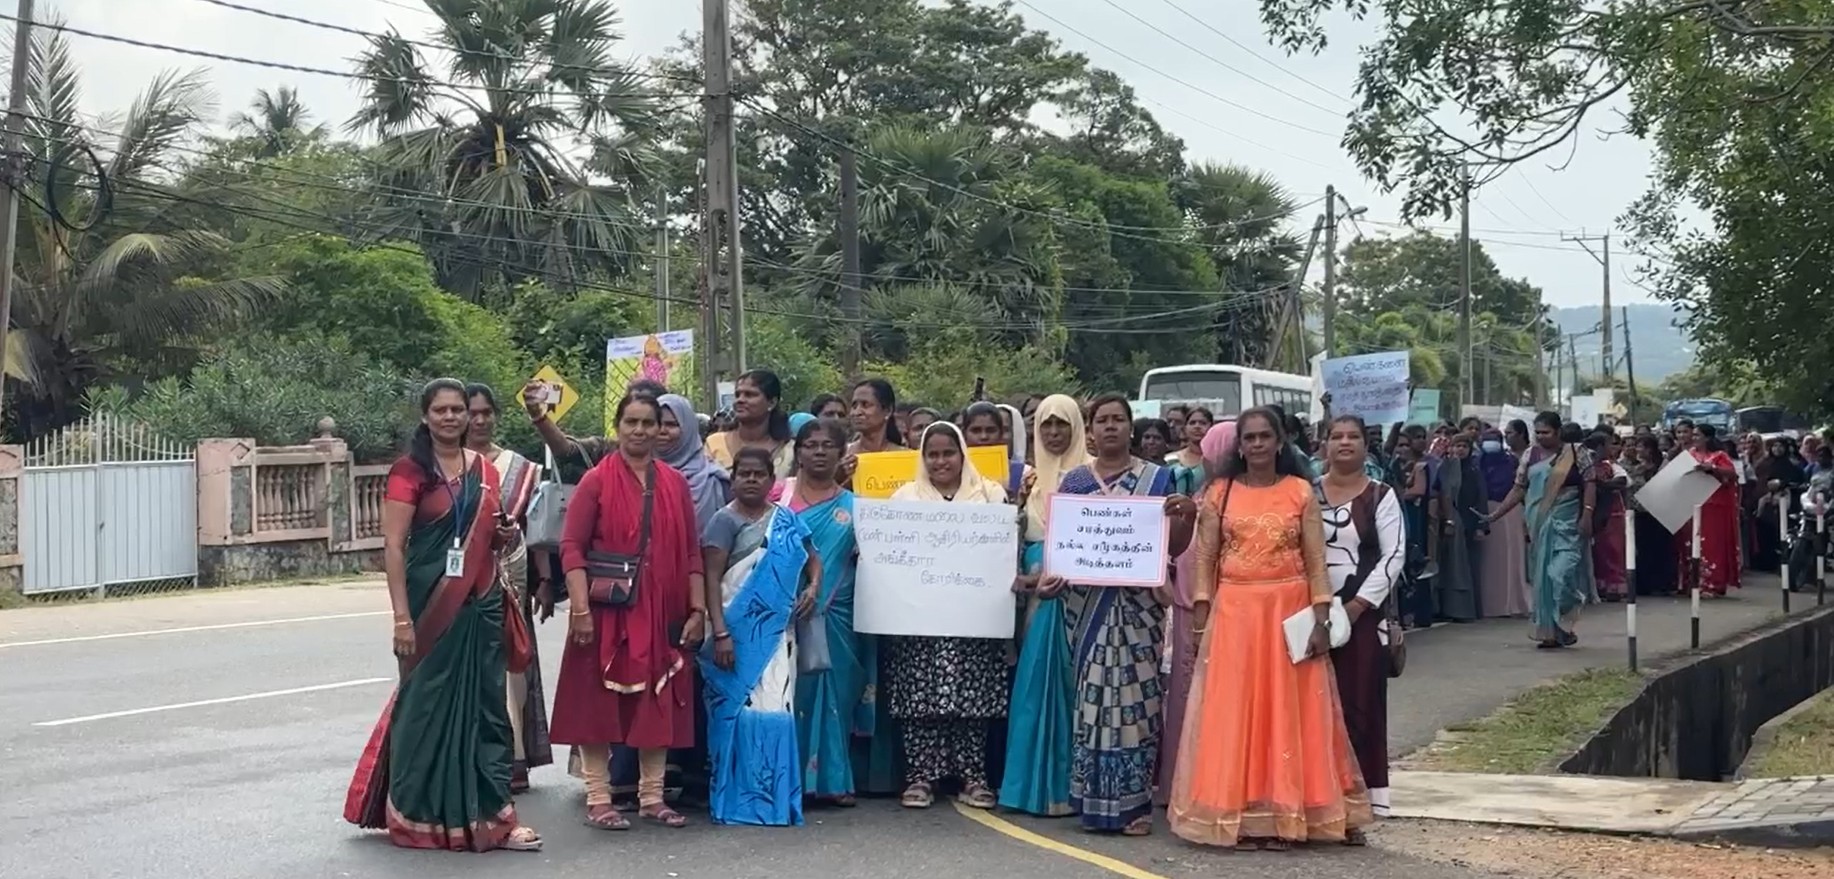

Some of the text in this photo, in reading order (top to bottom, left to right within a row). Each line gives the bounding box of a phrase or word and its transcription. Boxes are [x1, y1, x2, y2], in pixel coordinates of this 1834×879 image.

[1081, 507, 1133, 518] பெண்கள்
[1077, 523, 1135, 536] சமத்துவம்
[1056, 539, 1153, 555] நல்ல சமூகத்தின்
[1075, 556, 1134, 569] அடித்தளம்
